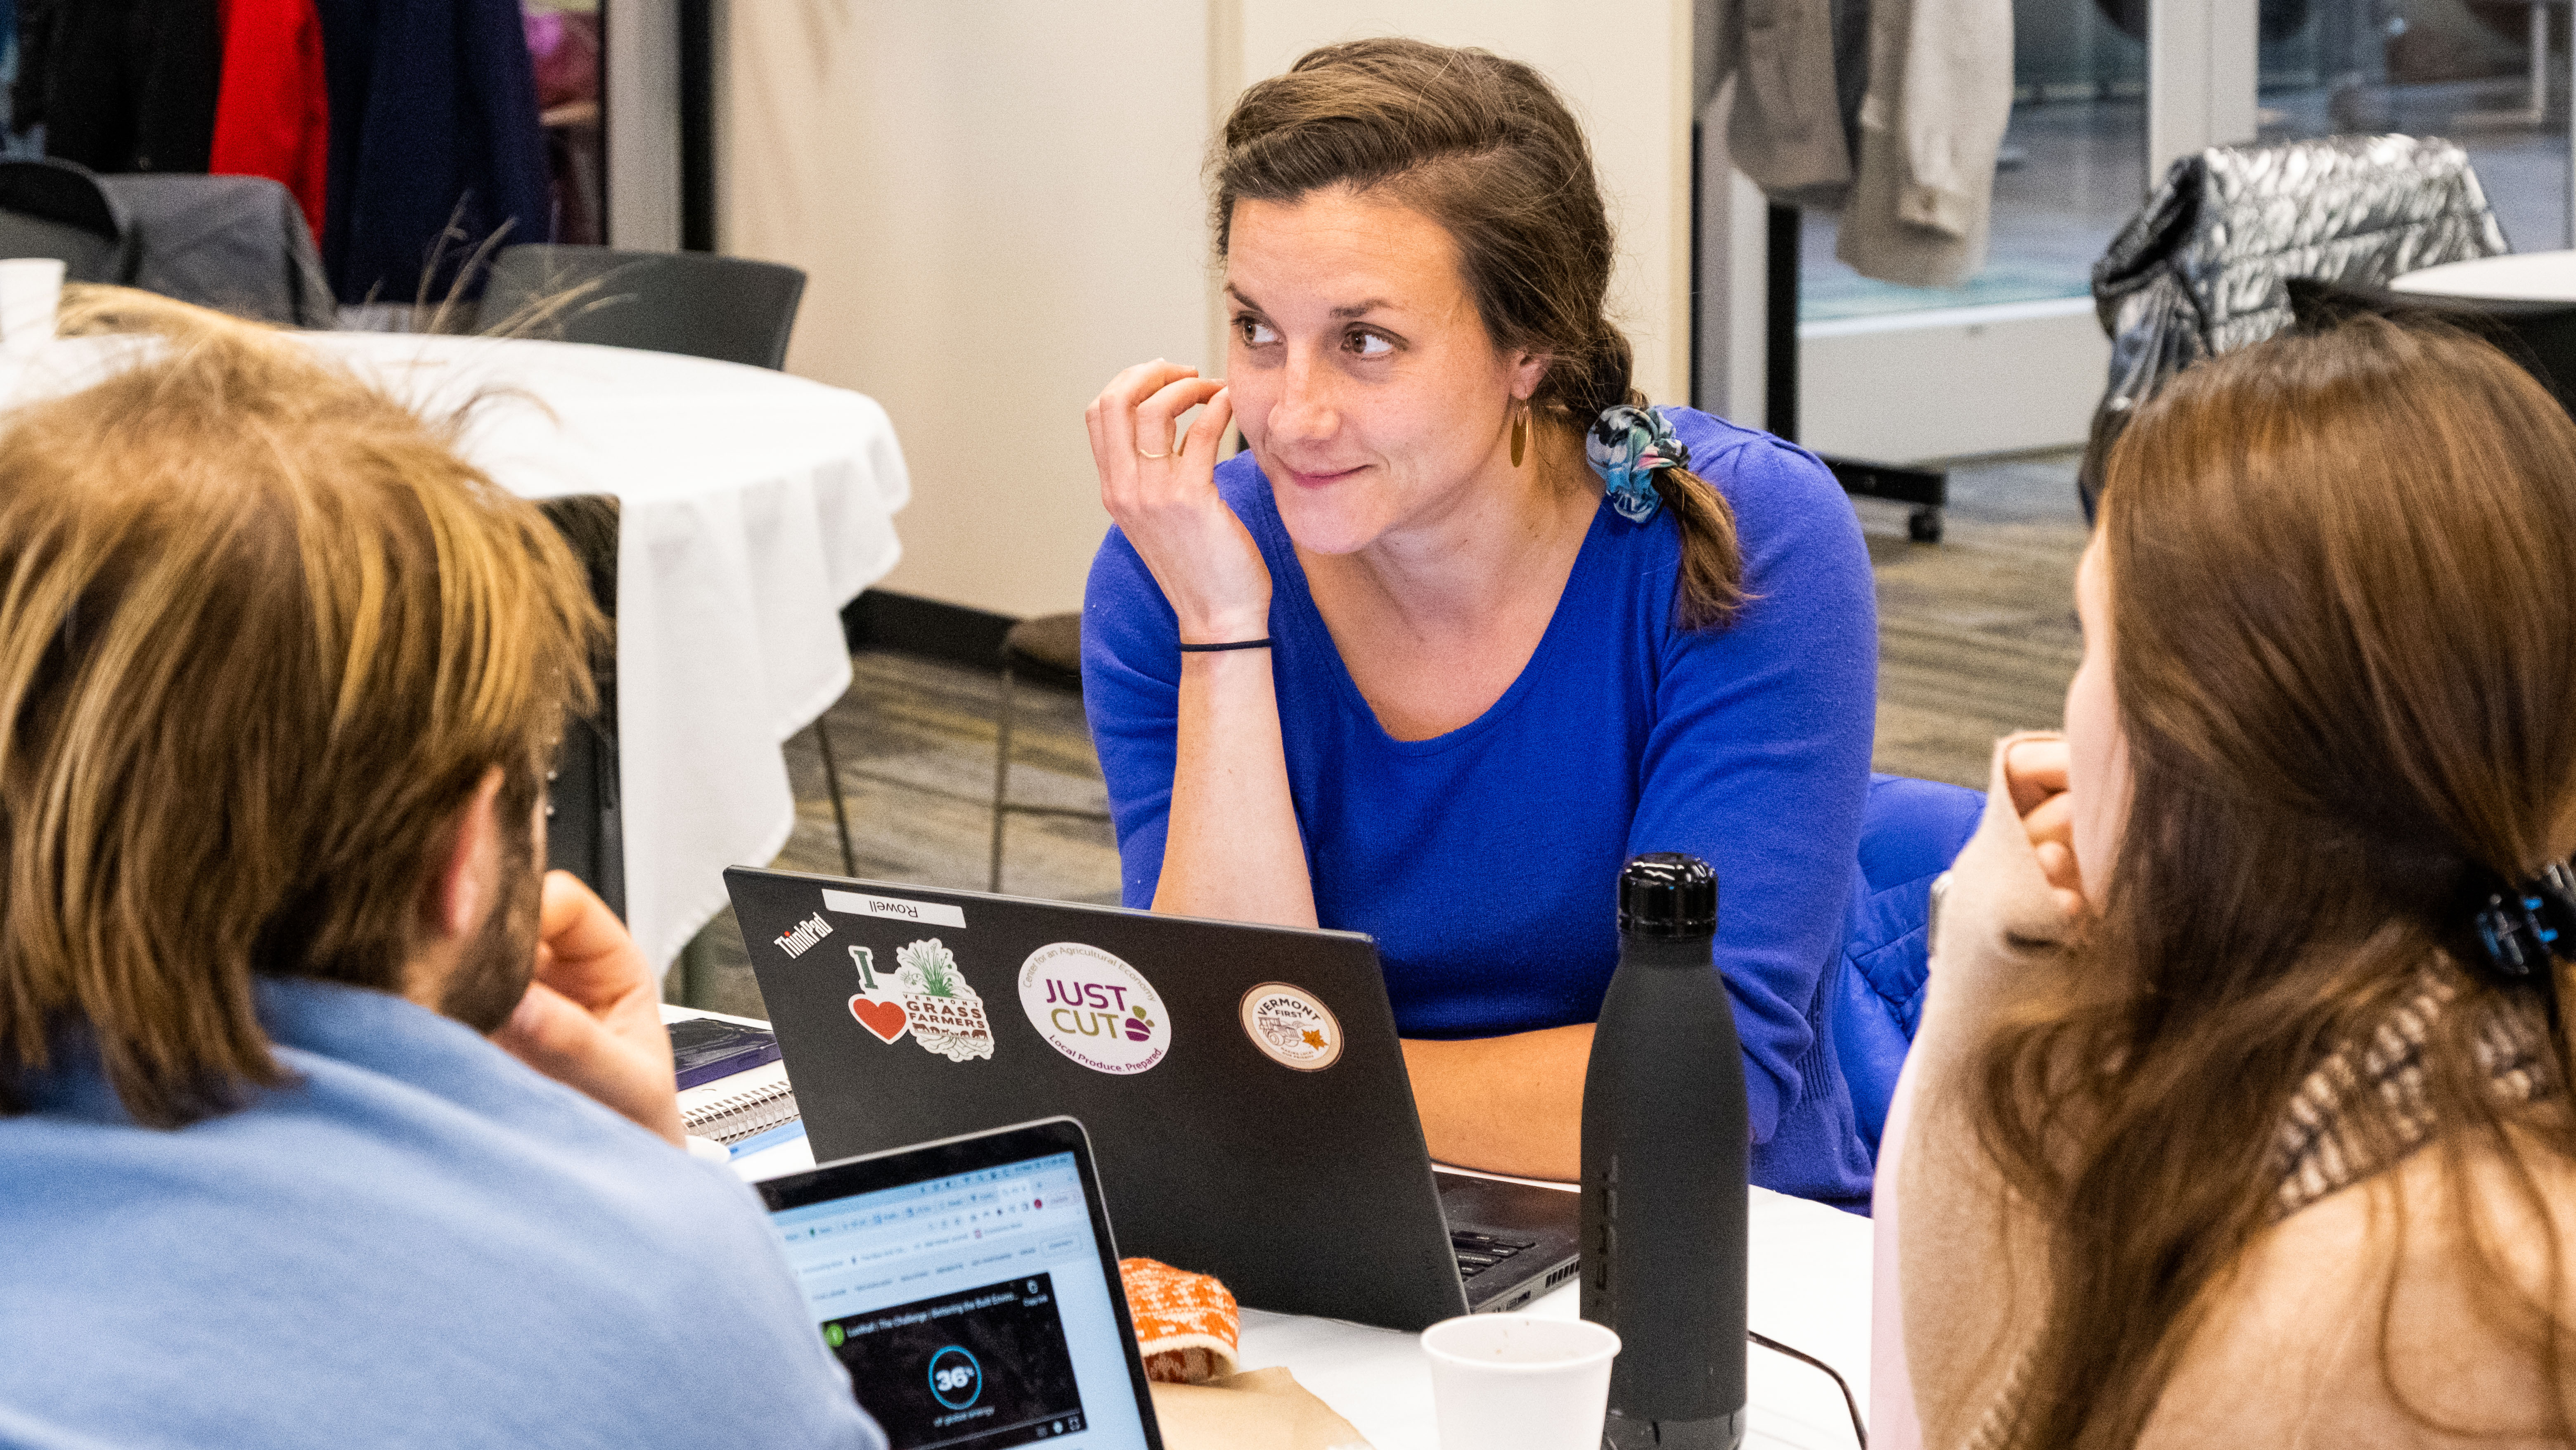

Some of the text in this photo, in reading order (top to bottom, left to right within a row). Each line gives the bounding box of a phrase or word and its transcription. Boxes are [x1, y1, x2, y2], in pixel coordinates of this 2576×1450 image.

[869, 901, 918, 917] Rowell
[774, 912, 833, 959] ThinkPad
[853, 950, 878, 989] I
[1023, 963, 1037, 988] Center
[1034, 955, 1046, 964] for
[1060, 947, 1117, 966] Agricultural
[1119, 964, 1155, 1002] Economy
[903, 994, 978, 1007] VERMONT
[1046, 979, 1127, 1011] JUST
[906, 1001, 982, 1019] GRASS
[909, 1012, 985, 1028] FARMERS
[1258, 998, 1321, 1021] VERMONT
[1275, 1009, 1302, 1018] FIRST
[1051, 1008, 1119, 1039] CUT
[1049, 1035, 1076, 1057] Local
